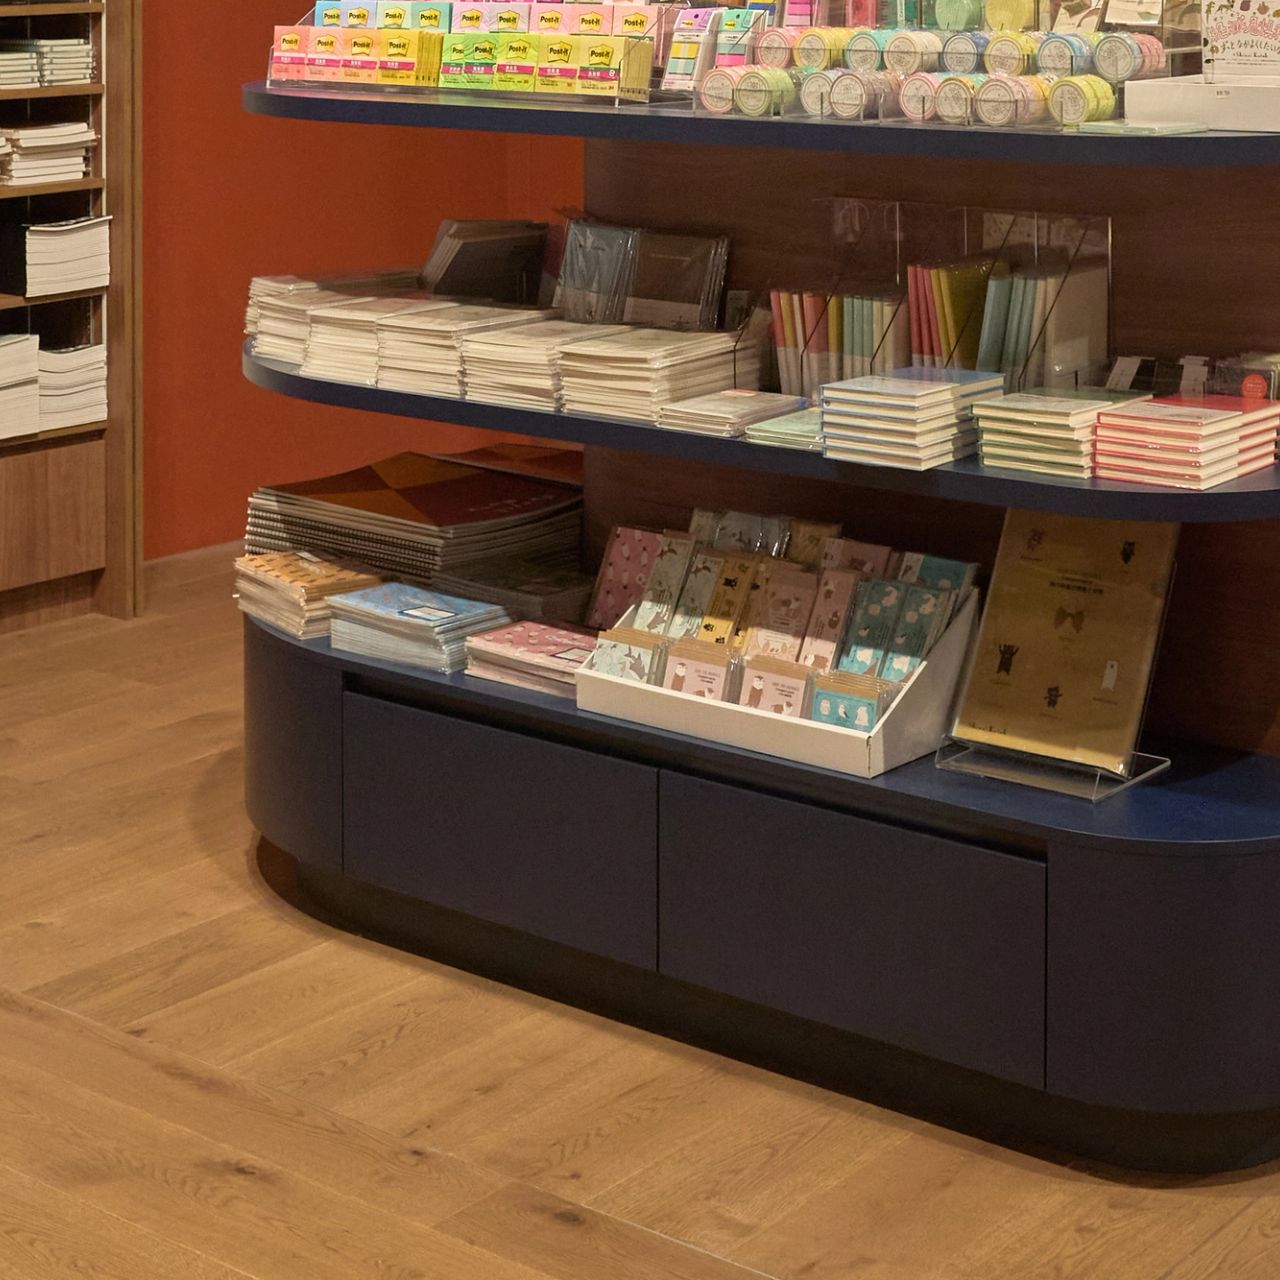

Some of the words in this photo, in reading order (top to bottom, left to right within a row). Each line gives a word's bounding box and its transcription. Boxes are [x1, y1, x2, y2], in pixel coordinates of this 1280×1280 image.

[349, 12, 366, 20] Post-it
[385, 12, 402, 20] Post-it
[420, 13, 438, 21] Post-it
[462, 14, 480, 22] Post-it
[540, 15, 559, 23] Post-it
[624, 19, 644, 27] Post-it
[317, 39, 334, 47] Post-it
[474, 47, 493, 55] Post-it
[508, 45, 527, 53] Post-it
[549, 47, 569, 56] Post-it
[590, 49, 610, 58] Post-it
